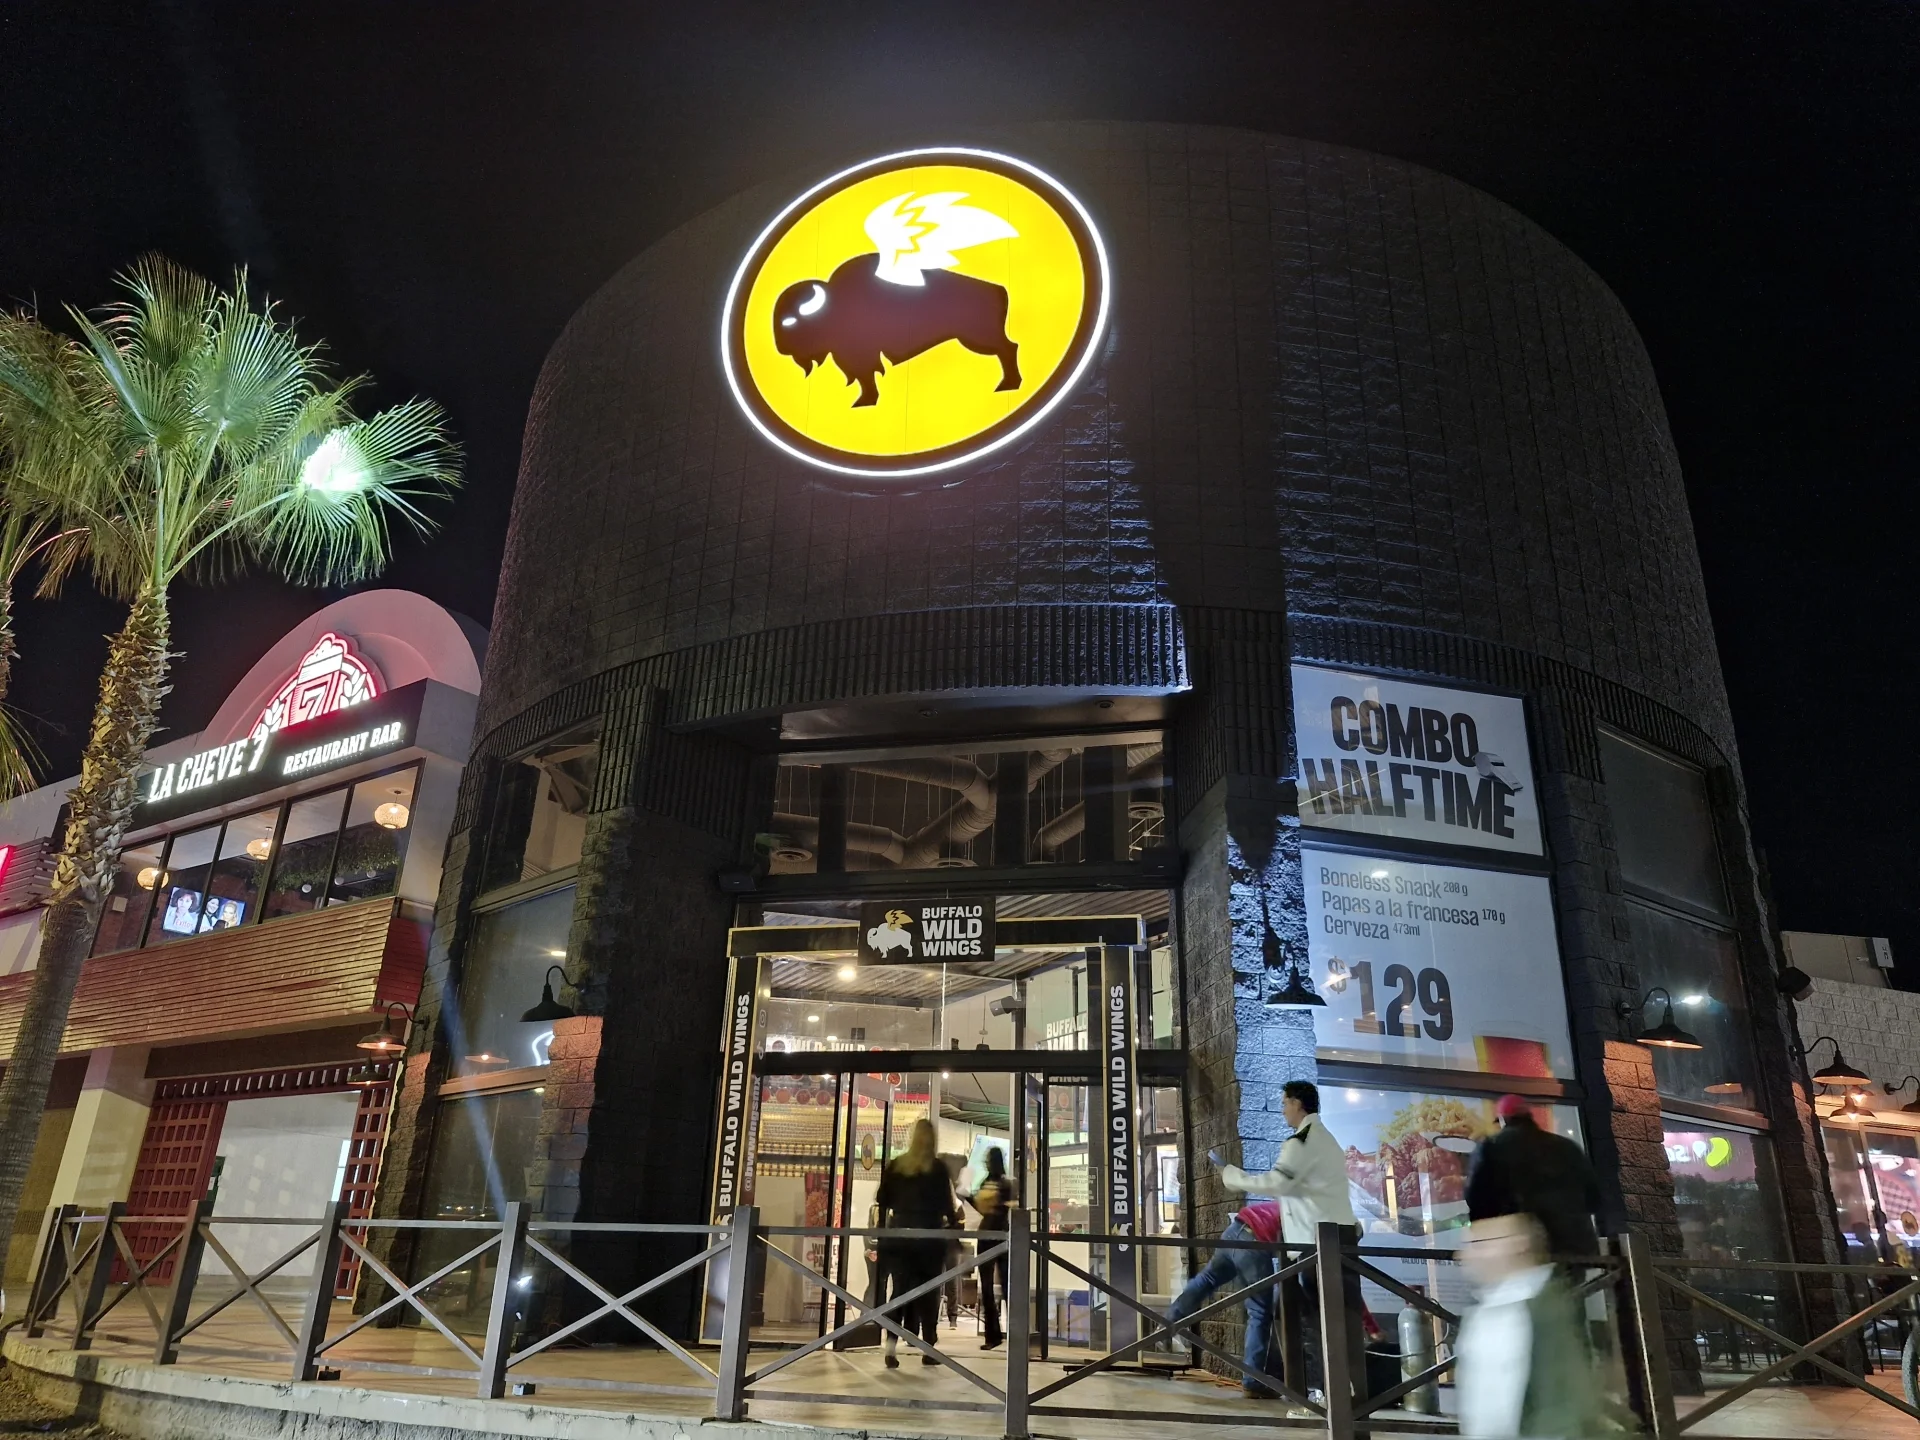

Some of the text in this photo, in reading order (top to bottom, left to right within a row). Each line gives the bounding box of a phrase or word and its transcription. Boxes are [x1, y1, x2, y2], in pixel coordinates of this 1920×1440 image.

[282, 721, 402, 776] RESTAURANT BAR
[1330, 695, 1479, 767] COMBO
[147, 723, 270, 803] LA CHEVE 7
[1302, 758, 1515, 839] HALFTIME
[1320, 866, 1391, 893] Boneless
[1395, 876, 1442, 899] Snack
[1461, 883, 1468, 897] g
[1322, 891, 1506, 926] Papas a la francesa 170 g
[921, 905, 983, 919] BUFFALO
[921, 918, 983, 941] WILD
[1324, 914, 1421, 940] Cerveza 473ml
[921, 939, 982, 957] WINGS
[719, 993, 750, 1207] BUFFALO WILD WINGS
[1111, 984, 1128, 1215] BUFFALO WILD WINGS
[744, 1076, 761, 1191] @bwwingsmx
